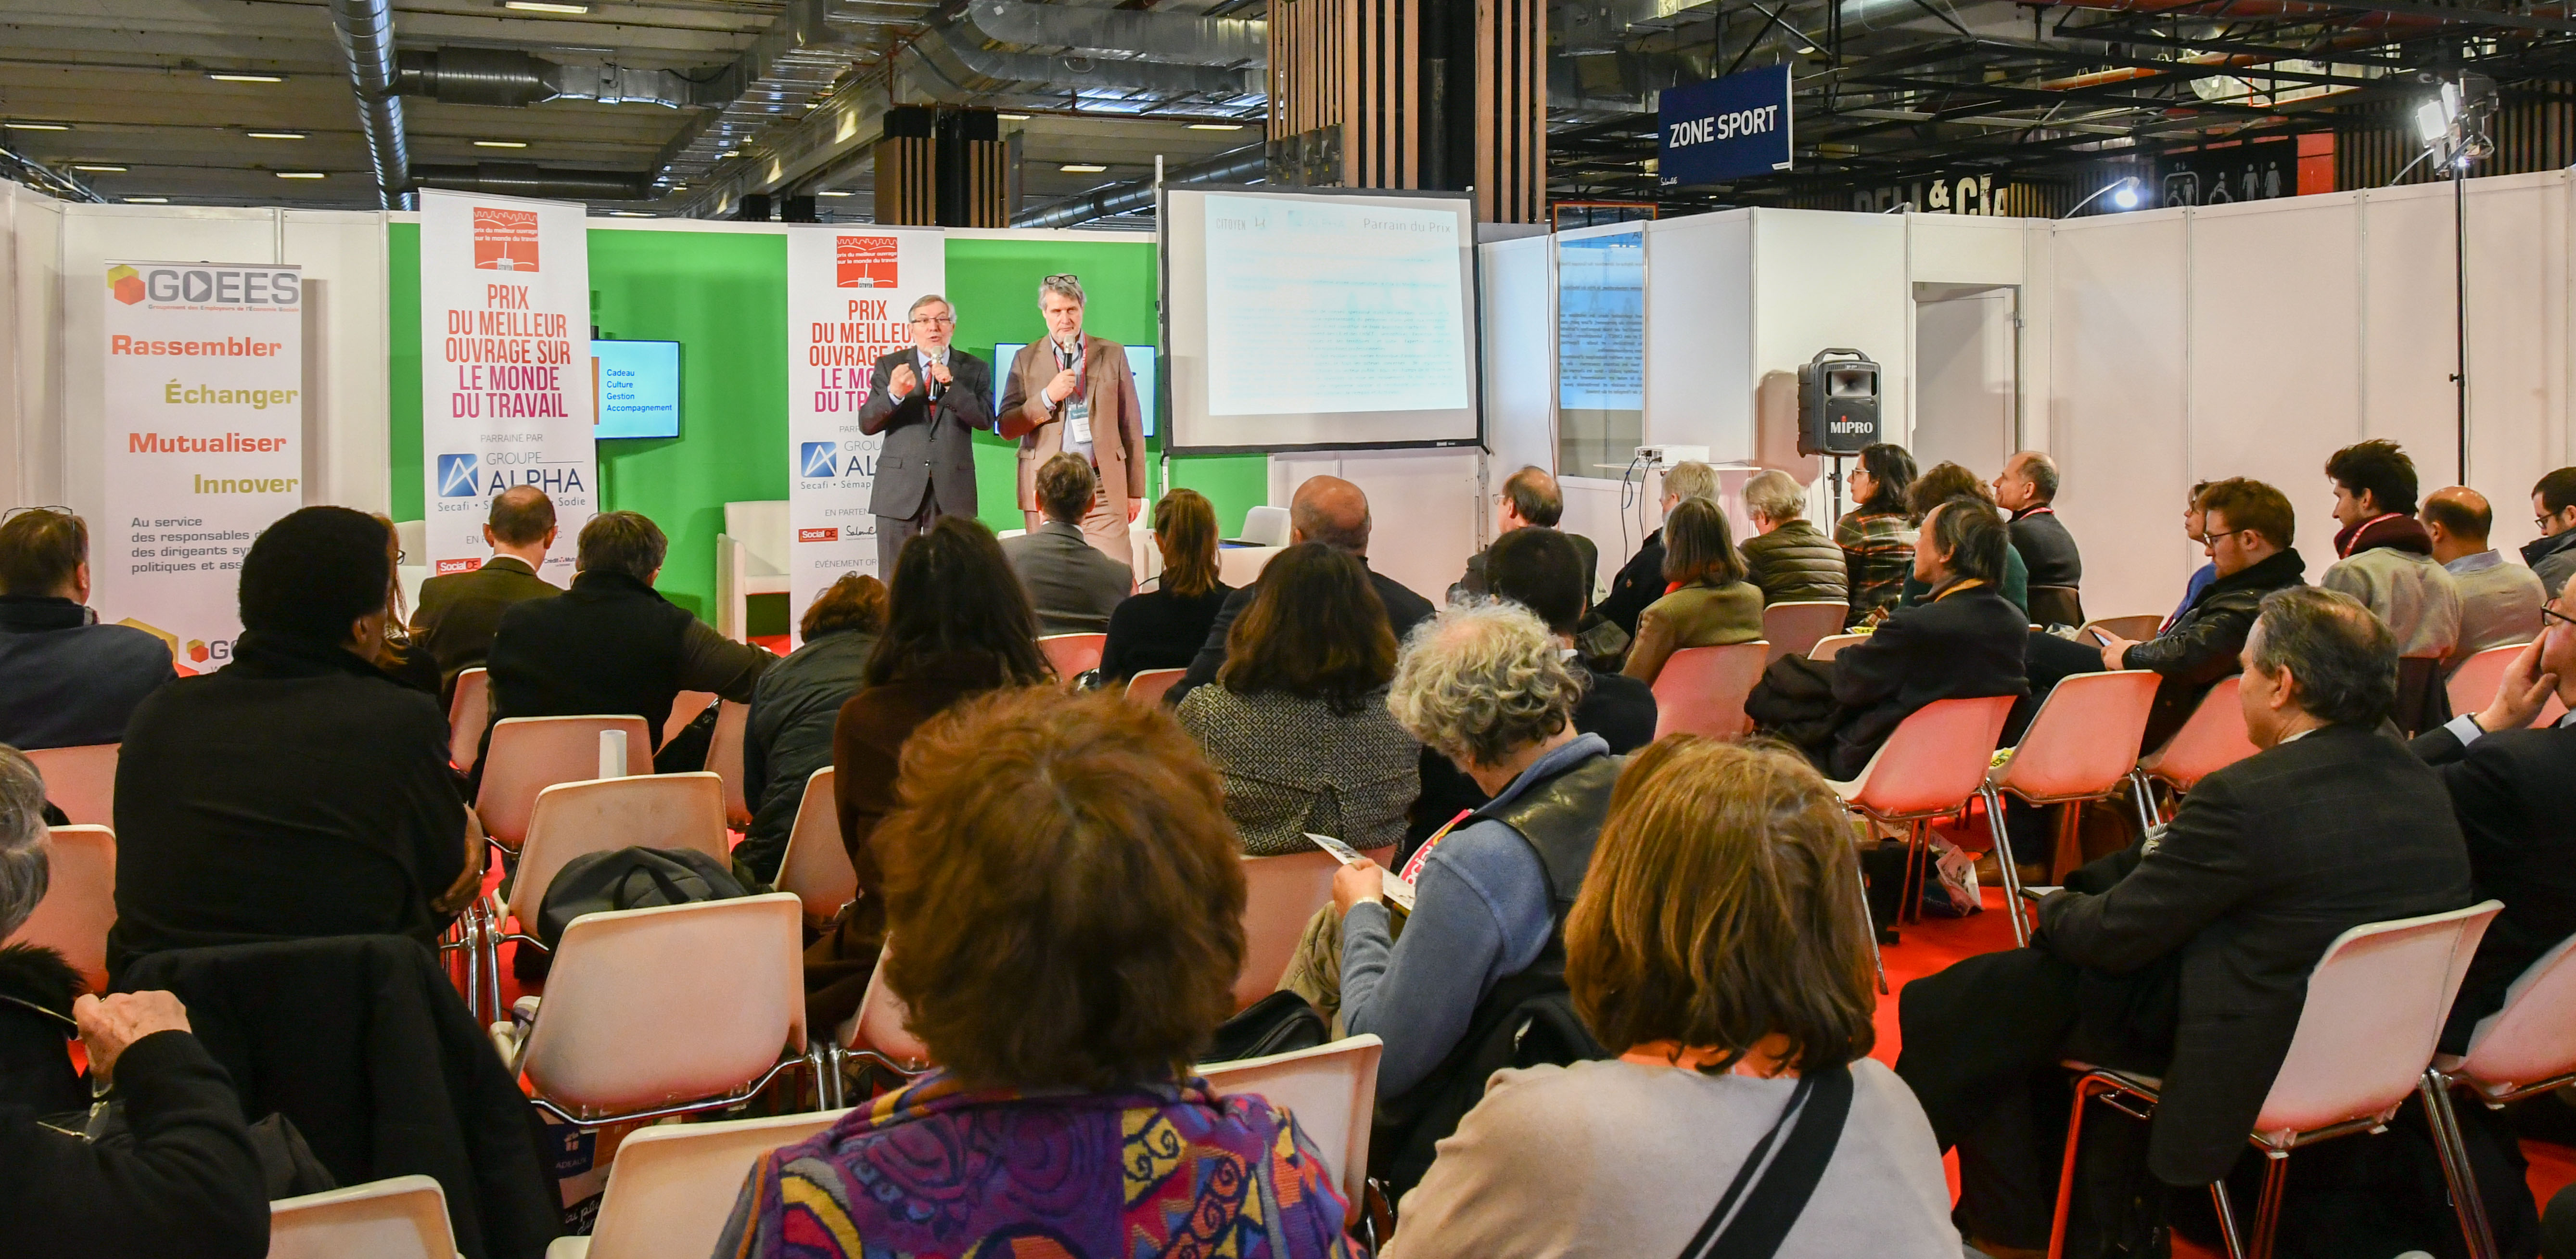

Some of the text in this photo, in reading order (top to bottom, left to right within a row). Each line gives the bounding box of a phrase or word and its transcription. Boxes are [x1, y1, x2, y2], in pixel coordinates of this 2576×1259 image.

[1670, 105, 1778, 149] ZONE SPORT
[1929, 179, 1950, 208] &
[1216, 218, 1246, 230] CITOYEN
[1364, 218, 1451, 232] Parrain du Prix
[148, 269, 299, 304] GOEES
[487, 284, 529, 310] PRIX
[848, 300, 887, 320] PRIX
[448, 309, 567, 338] DU MEILLEUR
[812, 322, 915, 343] DU MEILLEU
[112, 335, 282, 357] Rassembler
[446, 337, 570, 364] OUVRAGE SUR
[459, 365, 560, 391] LE MONDE
[821, 368, 842, 389] LE
[165, 379, 298, 409] Échanger
[815, 391, 839, 412] DU
[452, 393, 568, 418] DU TRAVAIL
[129, 433, 286, 453] Mutualiser
[844, 441, 882, 451] GROU
[486, 452, 542, 465] GROUPE
[845, 455, 875, 477] AL
[194, 474, 298, 494] Innover
[801, 481, 871, 490] Secafi Sémap
[438, 496, 586, 511] Secafi Sodie
[131, 516, 202, 527] Au service
[132, 533, 155, 543] des
[161, 530, 249, 544] responsables
[467, 535, 479, 544] EN
[802, 530, 836, 538] SocialCE
[132, 547, 155, 557] des
[161, 546, 227, 559] dirigeants
[132, 561, 242, 575] politiques et ass
[440, 560, 479, 572] SocialCE
[556, 1157, 587, 1169] ADEAUX
